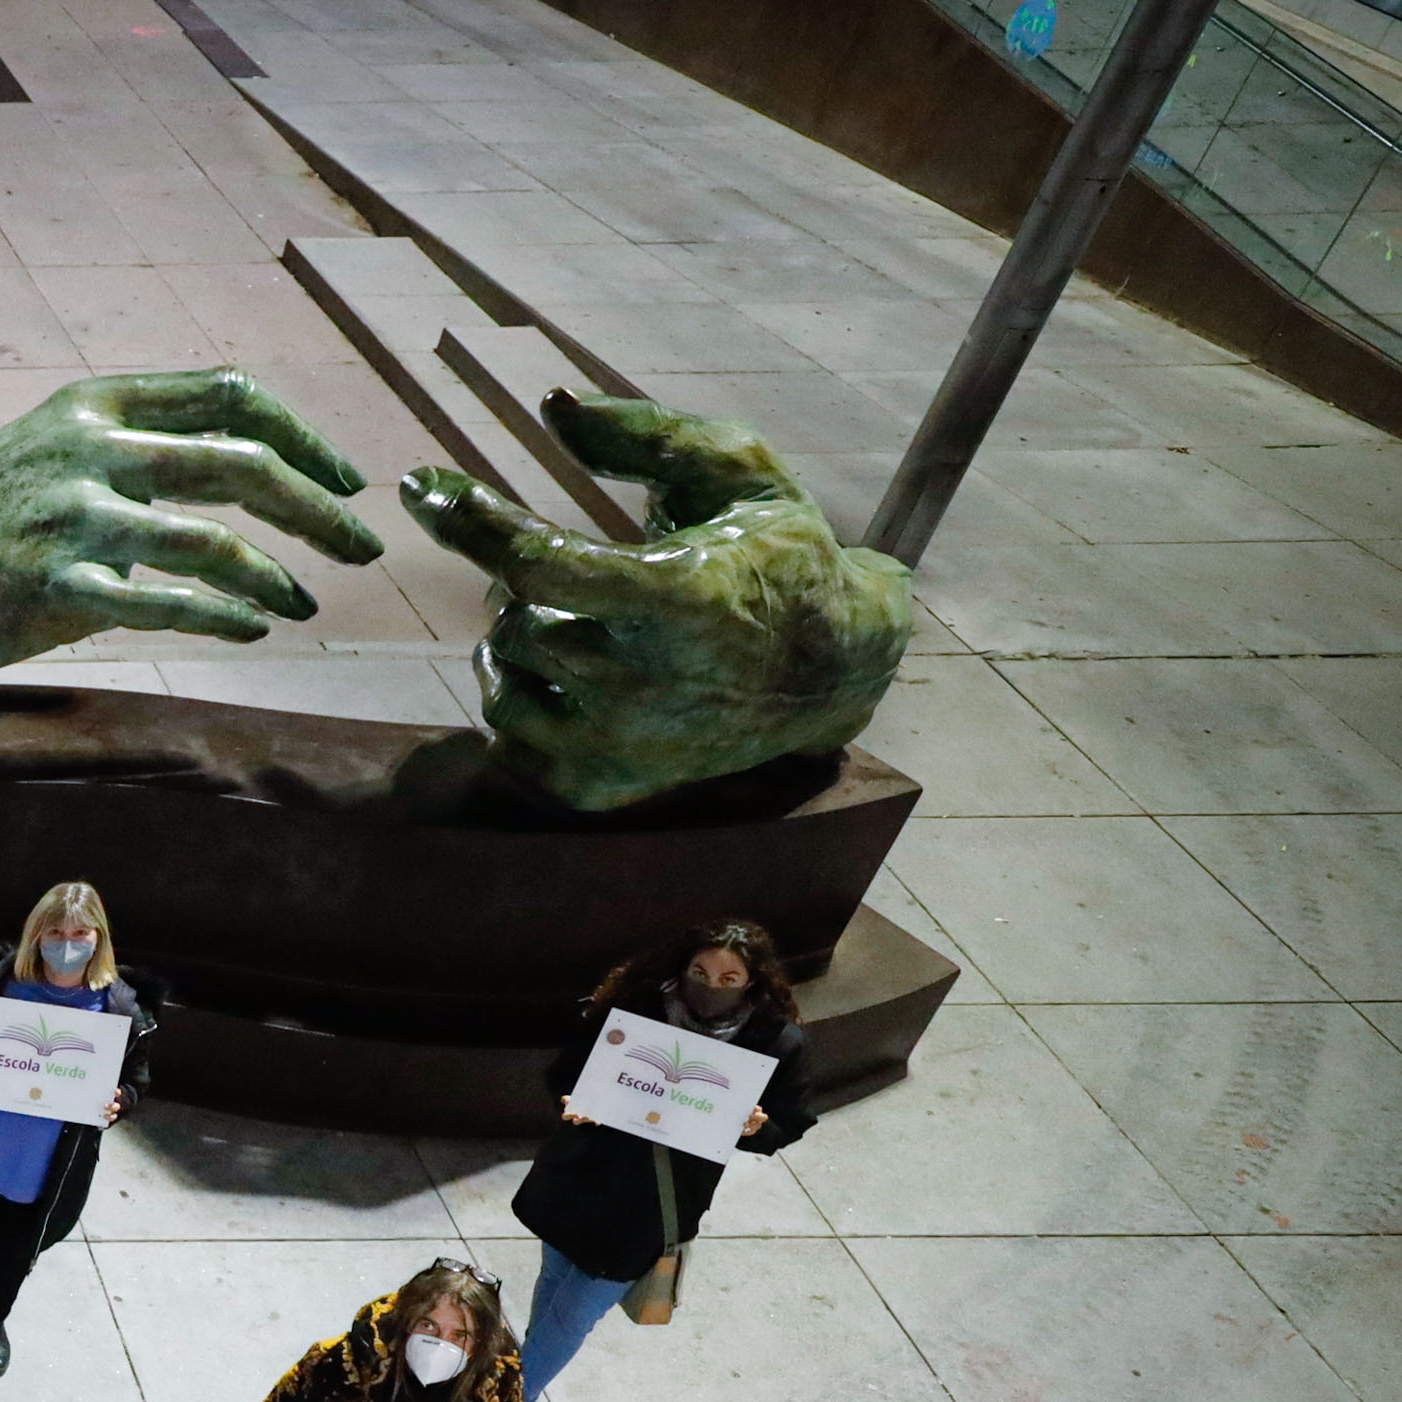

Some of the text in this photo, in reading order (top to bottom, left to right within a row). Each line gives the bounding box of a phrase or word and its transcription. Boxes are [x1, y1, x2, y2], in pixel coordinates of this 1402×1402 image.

[45, 1063, 87, 1080] Verda
[617, 1072, 714, 1112] Escola Verda
